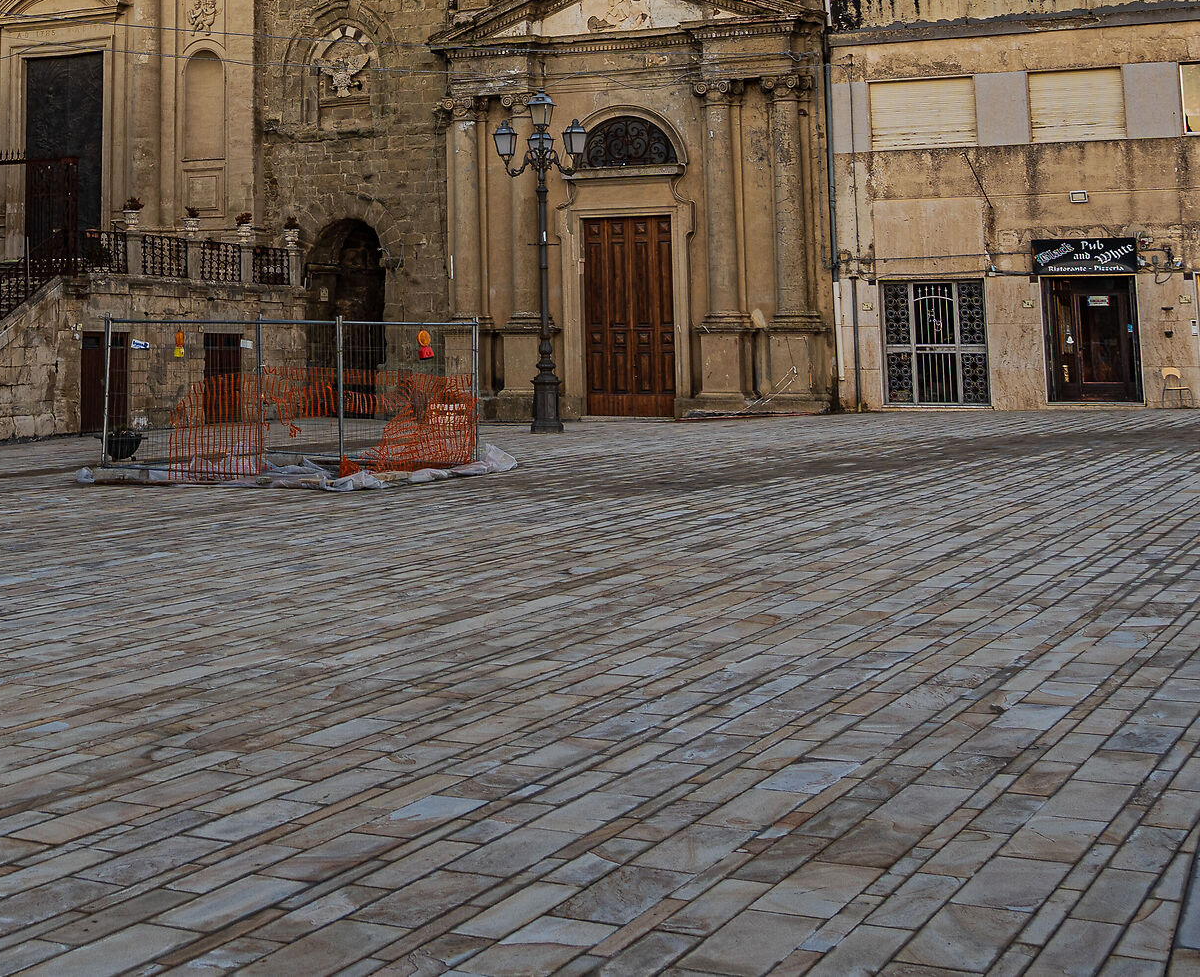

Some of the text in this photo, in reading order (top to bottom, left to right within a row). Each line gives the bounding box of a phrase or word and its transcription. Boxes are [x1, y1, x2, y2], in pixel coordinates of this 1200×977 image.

[1080, 239, 1104, 250] Pub
[1034, 242, 1134, 266] Black and White
